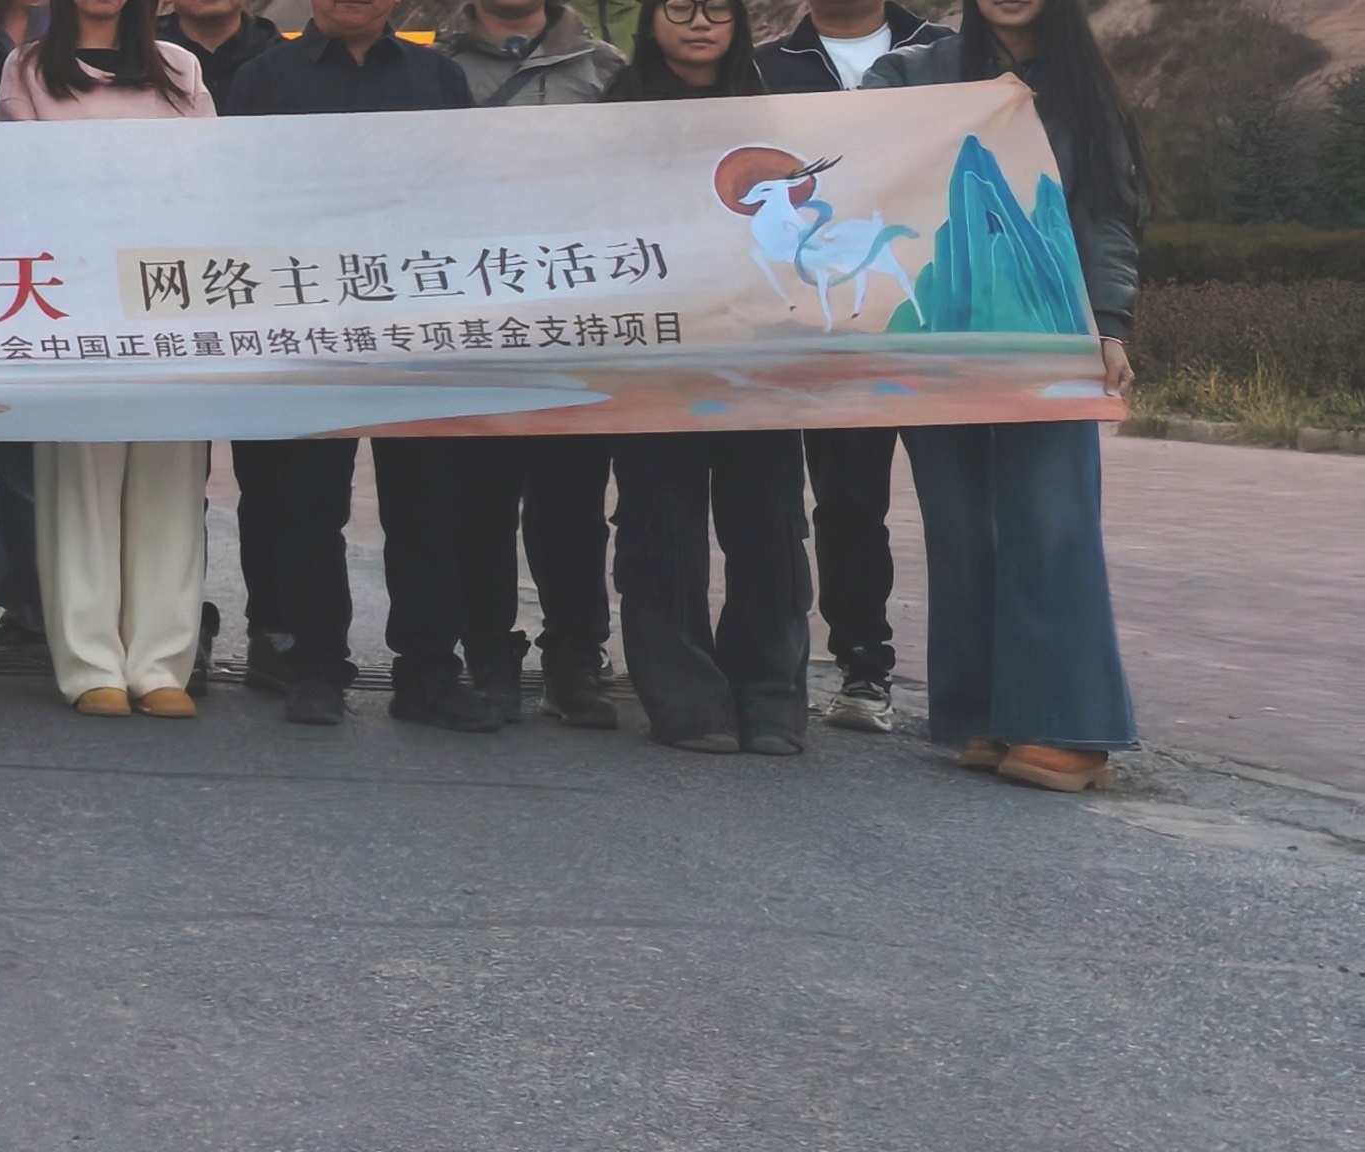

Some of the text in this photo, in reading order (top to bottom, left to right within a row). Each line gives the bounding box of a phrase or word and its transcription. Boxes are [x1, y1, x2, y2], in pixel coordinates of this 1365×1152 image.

[139, 237, 669, 312] 网络主题宣传活动
